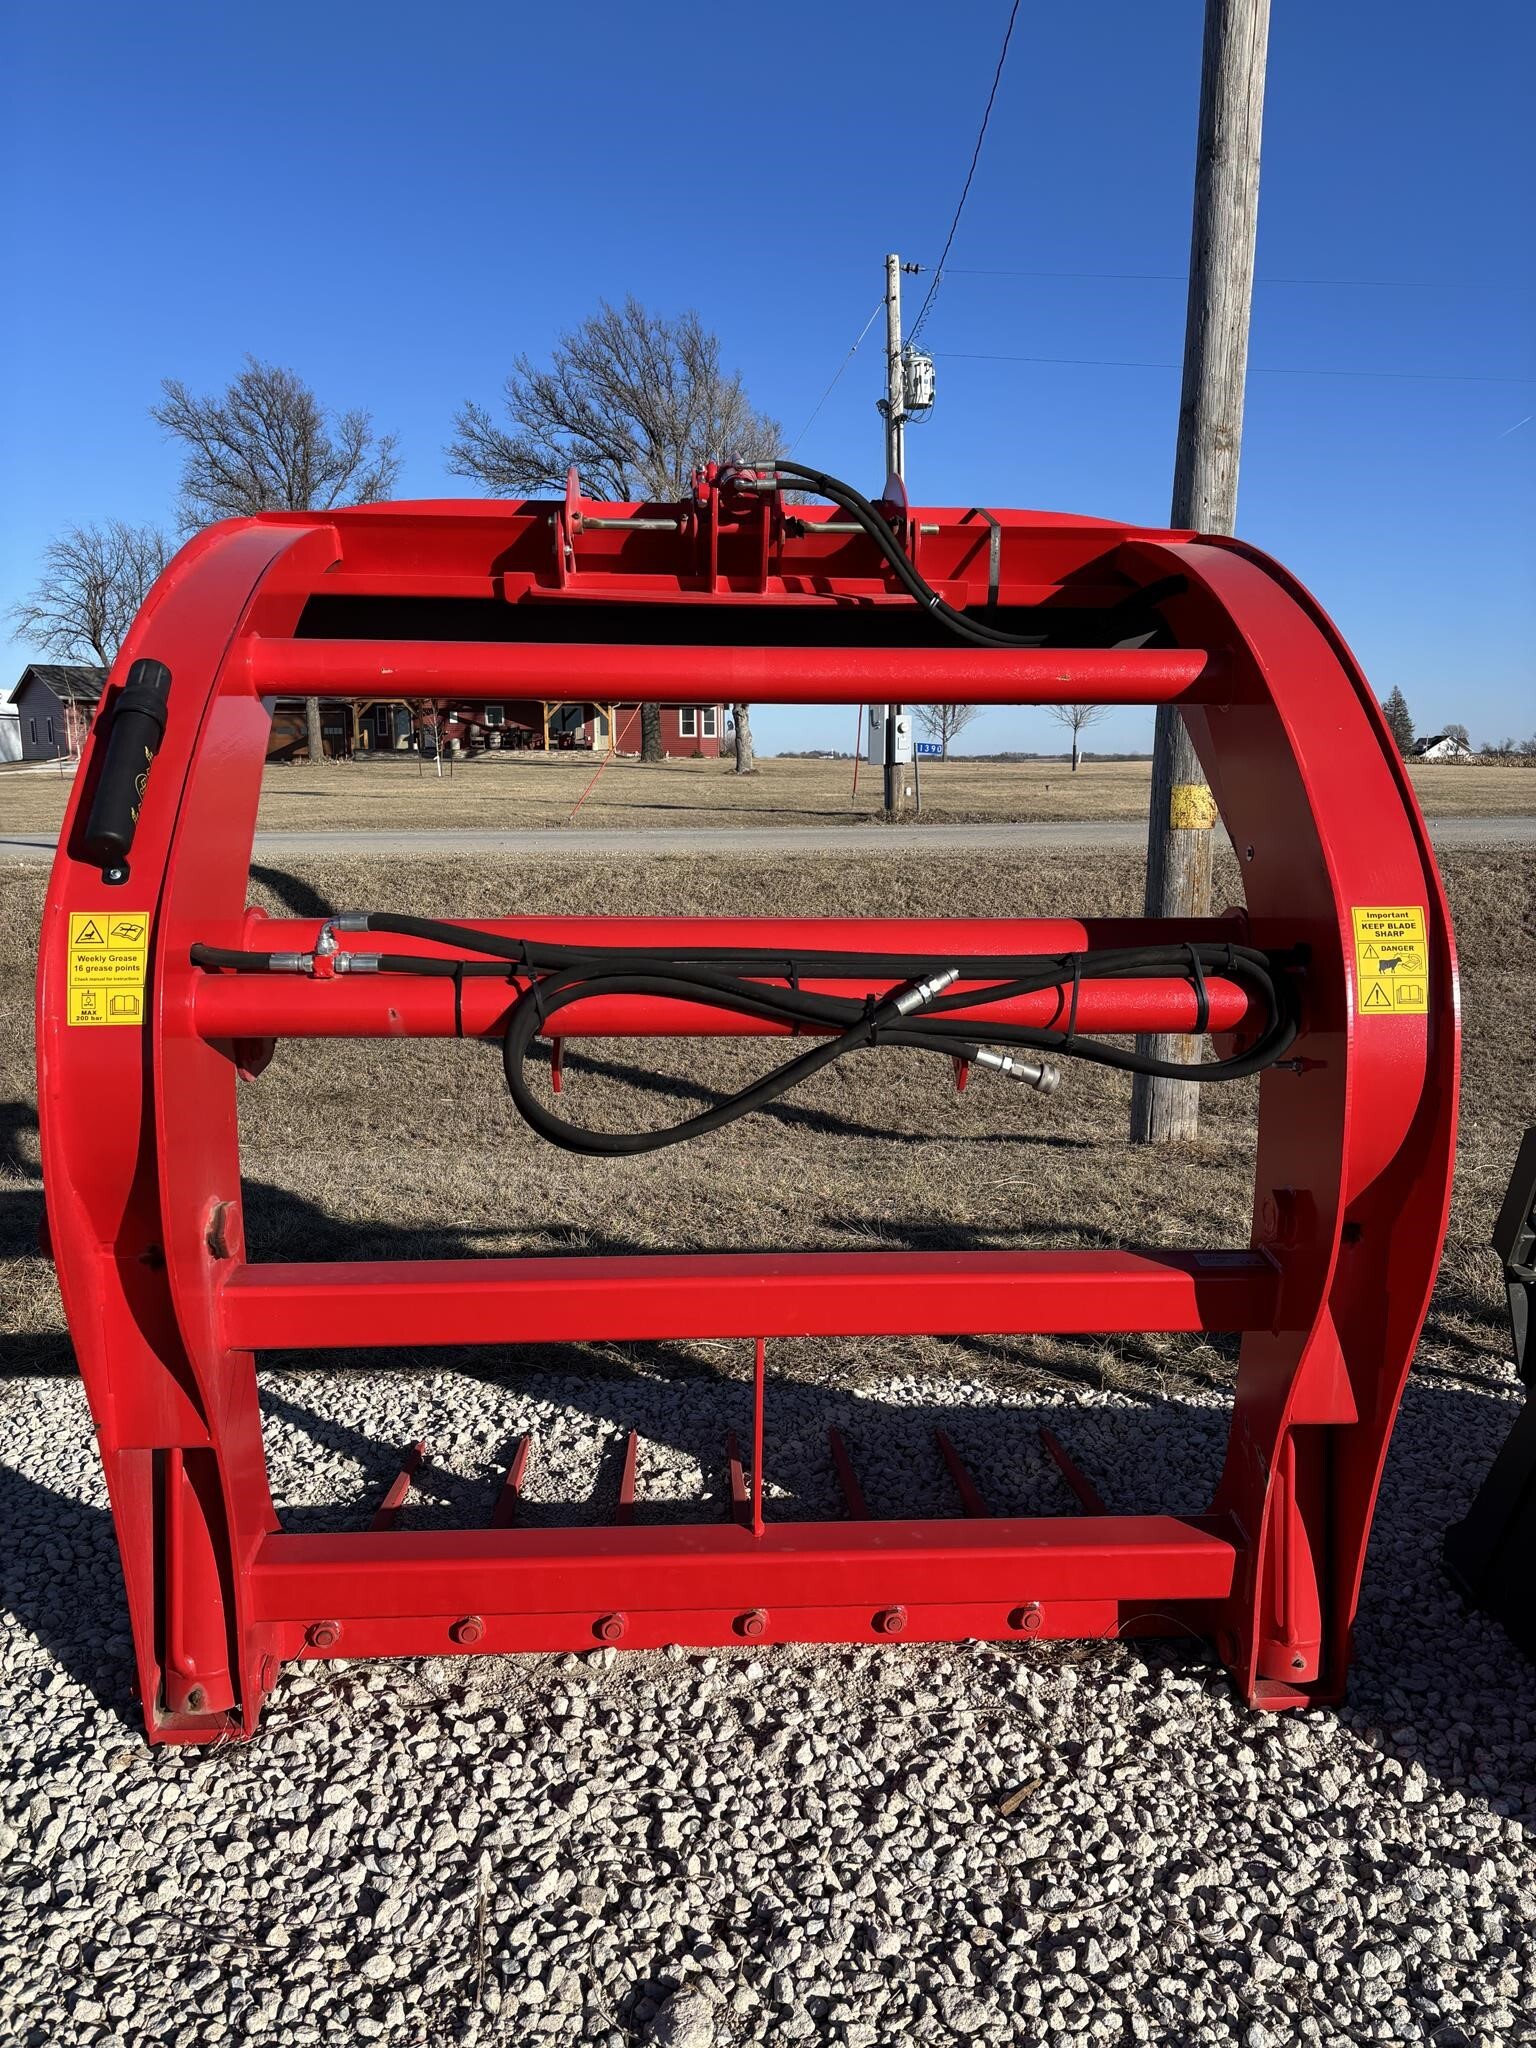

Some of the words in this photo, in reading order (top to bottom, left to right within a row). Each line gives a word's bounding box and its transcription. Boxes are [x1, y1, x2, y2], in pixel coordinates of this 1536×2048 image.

[919, 744, 942, 753] 1390
[77, 955, 107, 963] Weekly
[108, 954, 137, 962] Grease
[115, 964, 140, 972] points
